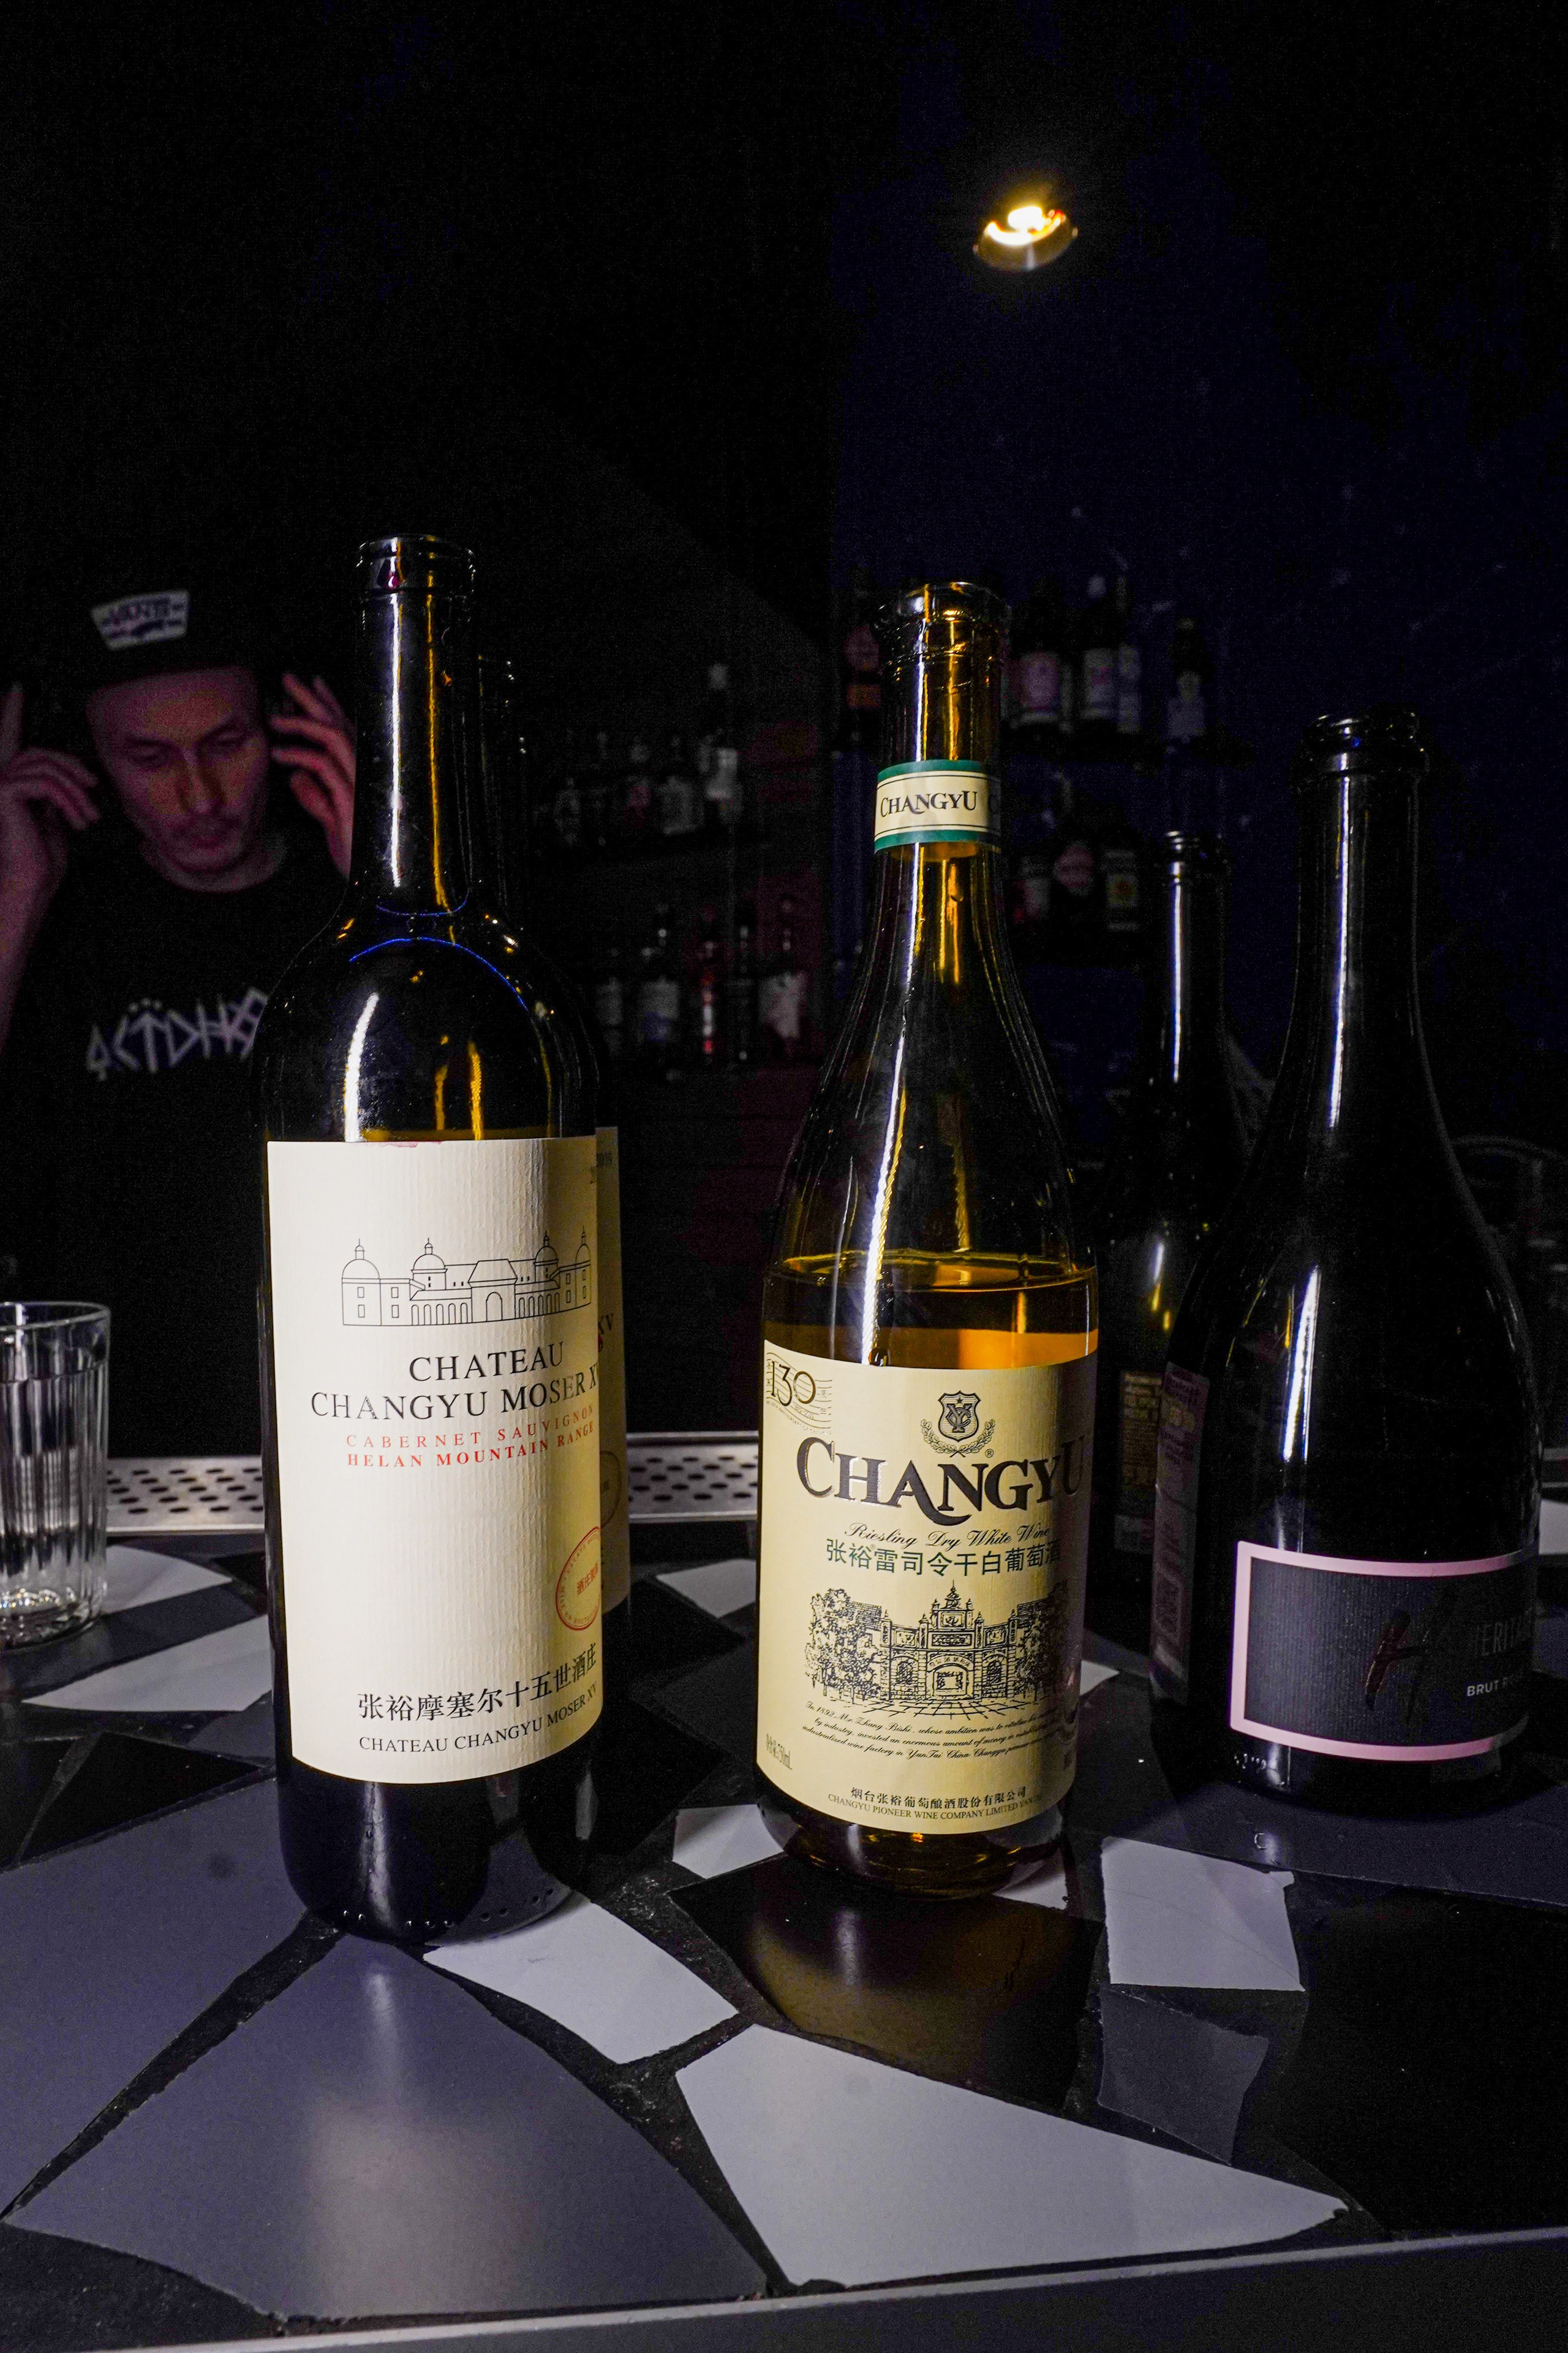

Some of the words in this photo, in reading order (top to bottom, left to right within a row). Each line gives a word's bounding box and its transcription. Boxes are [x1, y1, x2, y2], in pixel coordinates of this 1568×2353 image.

[881, 790, 978, 818] CHANGYU
[409, 1341, 564, 1381] CHATEAU
[311, 1391, 488, 1420] CHANGYU
[501, 1372, 586, 1413] MOSER
[771, 1361, 816, 1407] 130
[346, 1431, 481, 1448] CABERNET
[498, 1403, 594, 1441] SAUVIGNON
[347, 1453, 422, 1467] HELAN
[436, 1438, 548, 1467] MOUNTAIN
[557, 1421, 594, 1448] RANGE
[797, 1435, 1085, 1526] CHANGYU
[845, 1522, 919, 1549] Riesling
[925, 1530, 962, 1552] Dry
[967, 1528, 1012, 1547] White
[1017, 1522, 1049, 1542] Wine
[358, 1642, 597, 1722] 张裕摩塞尔十五世酒庄
[1466, 1680, 1499, 1697] BRUT
[359, 1736, 448, 1753] CHATEAU
[454, 1717, 542, 1750] CHANGYU
[547, 1694, 586, 1727] MOSER
[802, 1724, 848, 1745] industrialized
[848, 1740, 865, 1749] wine
[864, 1744, 894, 1756] factory
[947, 1749, 971, 1759] China
[814, 1717, 823, 1726] by
[858, 1731, 889, 1742] invested
[973, 1735, 986, 1747] of
[984, 1735, 1007, 1745] money
[854, 1717, 883, 1731] Zhang
[919, 1726, 943, 1735] whose
[945, 1724, 978, 1735] ambition
[828, 1793, 871, 1812] CHANGYU
[873, 1805, 911, 1818] PIONEER
[914, 1810, 938, 1819] WINE
[940, 1809, 984, 1819] COMPANY
[986, 1802, 1019, 1816] LIMITED
[851, 1786, 1027, 1810] 烟台张裕葡萄酿酒股份有限公司
